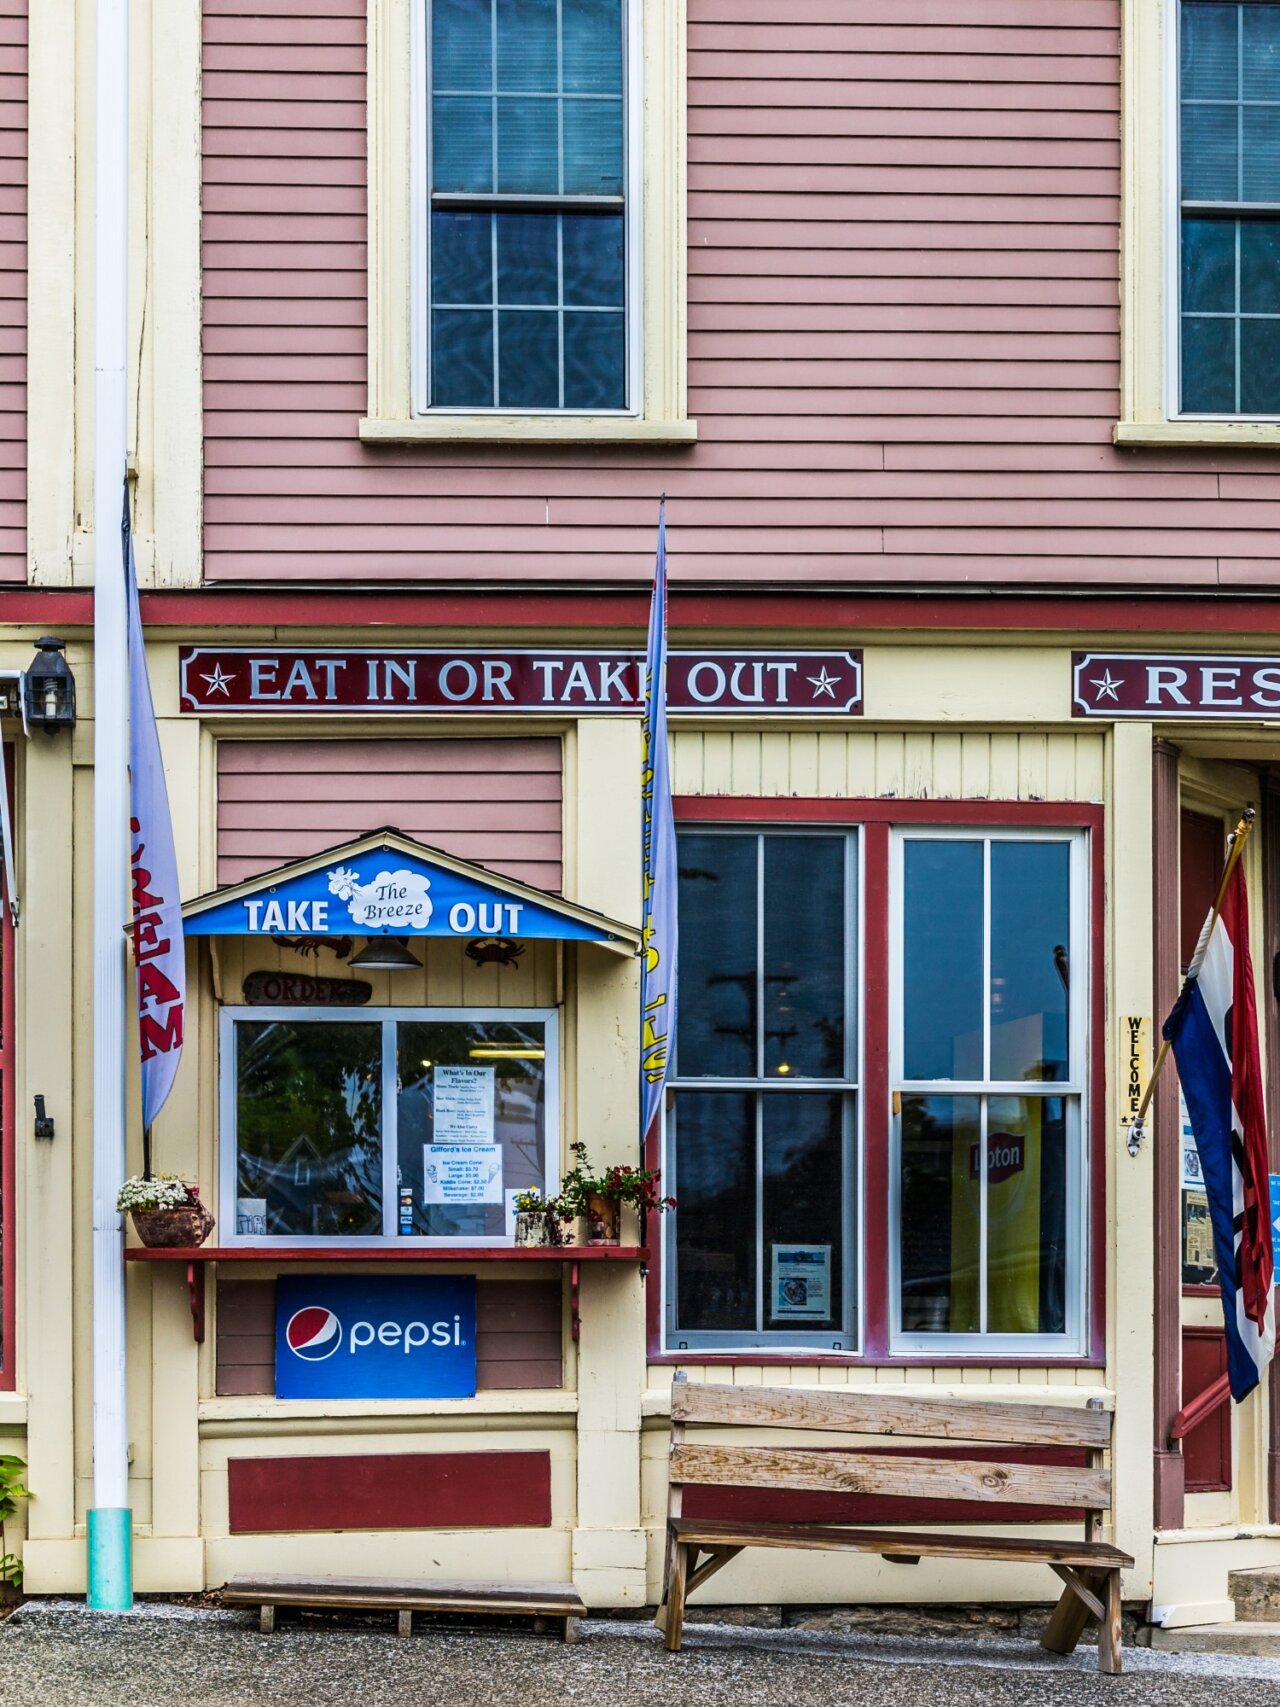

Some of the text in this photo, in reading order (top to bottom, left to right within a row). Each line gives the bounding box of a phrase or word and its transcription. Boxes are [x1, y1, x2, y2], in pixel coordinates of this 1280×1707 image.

[248, 659, 347, 700] EAT
[366, 659, 417, 700] IN
[438, 659, 515, 701] OR
[686, 661, 798, 703] OUT
[375, 882, 408, 901] The
[243, 900, 329, 932] TAKE
[363, 900, 423, 920] Breeze
[448, 902, 524, 934] OUT
[263, 979, 346, 1002] ORDER
[1128, 1017, 1142, 1112] WELCOME
[974, 1146, 1020, 1171] Lpton
[350, 1314, 461, 1354] pepsi
